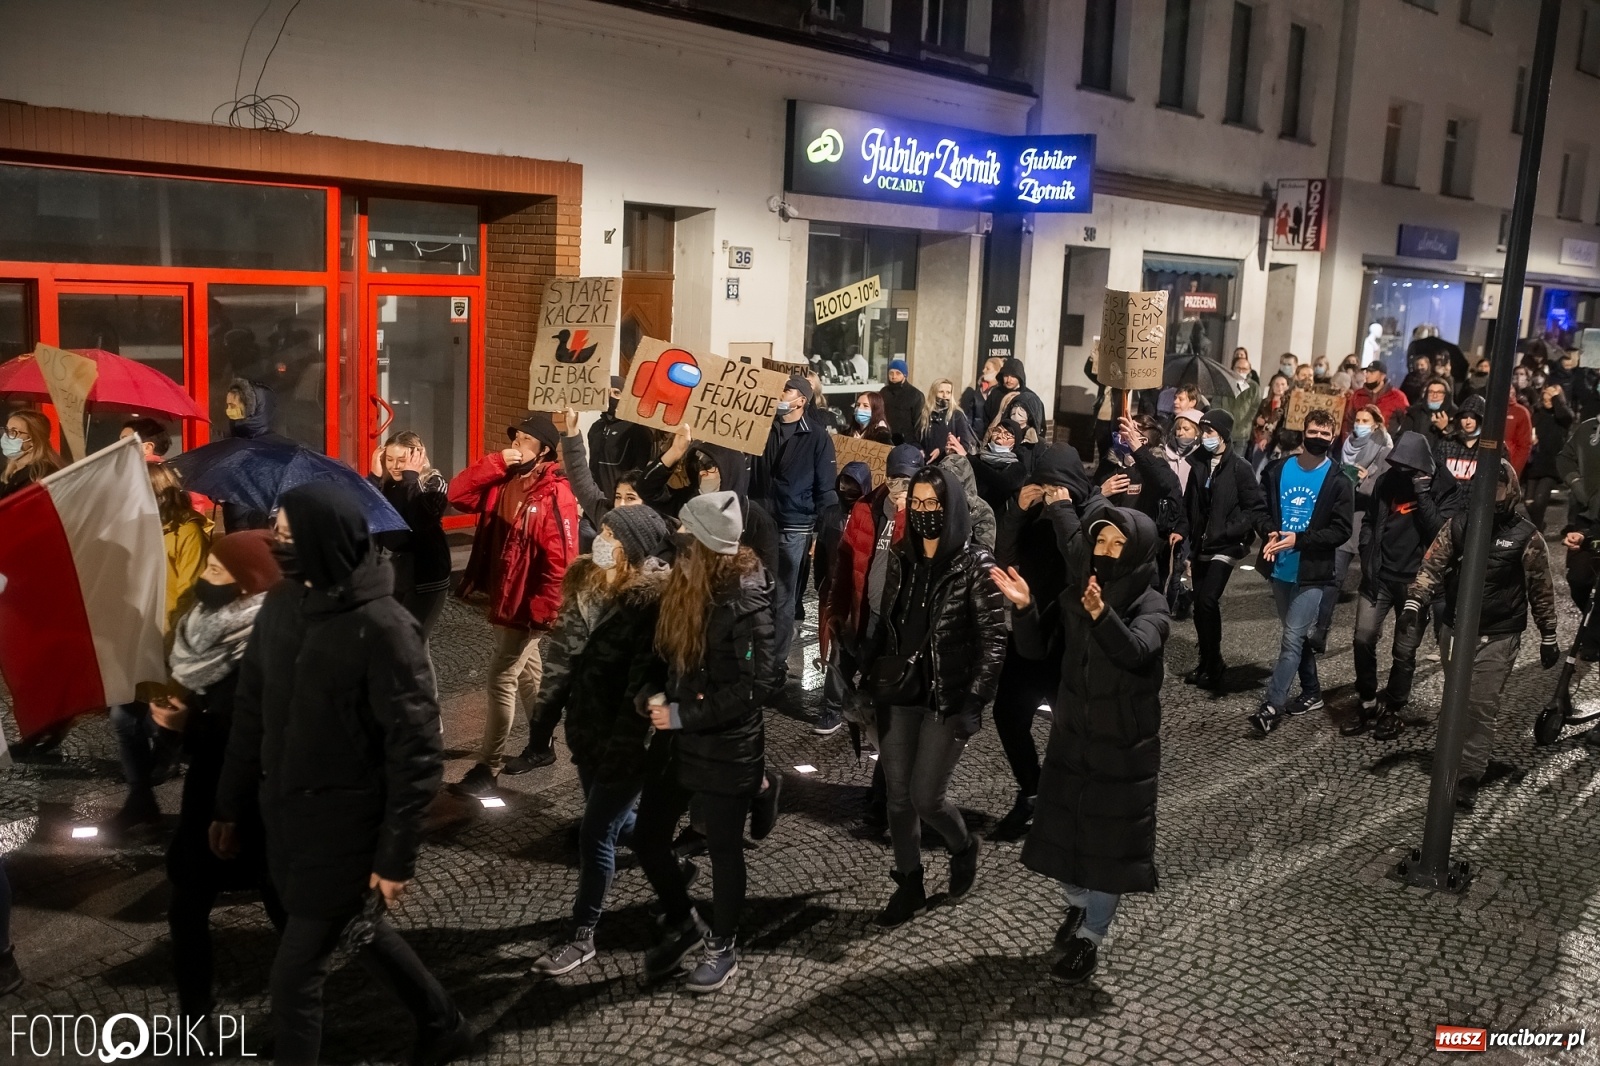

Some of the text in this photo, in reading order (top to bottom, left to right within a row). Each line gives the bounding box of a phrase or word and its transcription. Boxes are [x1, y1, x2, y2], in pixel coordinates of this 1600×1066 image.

[861, 128, 1001, 188] Jubiler Złotnik
[1019, 148, 1077, 176] Jubiler
[1018, 178, 1076, 204] Złotnik
[735, 250, 752, 265] 36
[548, 279, 614, 304] STARE
[816, 281, 880, 320] ZŁOTO -10%
[1184, 295, 1217, 309] PRZECENA
[544, 304, 609, 326] KACZKI
[538, 357, 601, 385] JEBAĆ
[720, 360, 760, 390] PIS
[700, 382, 778, 418] FEJKUJE
[693, 405, 755, 441] TASKI
